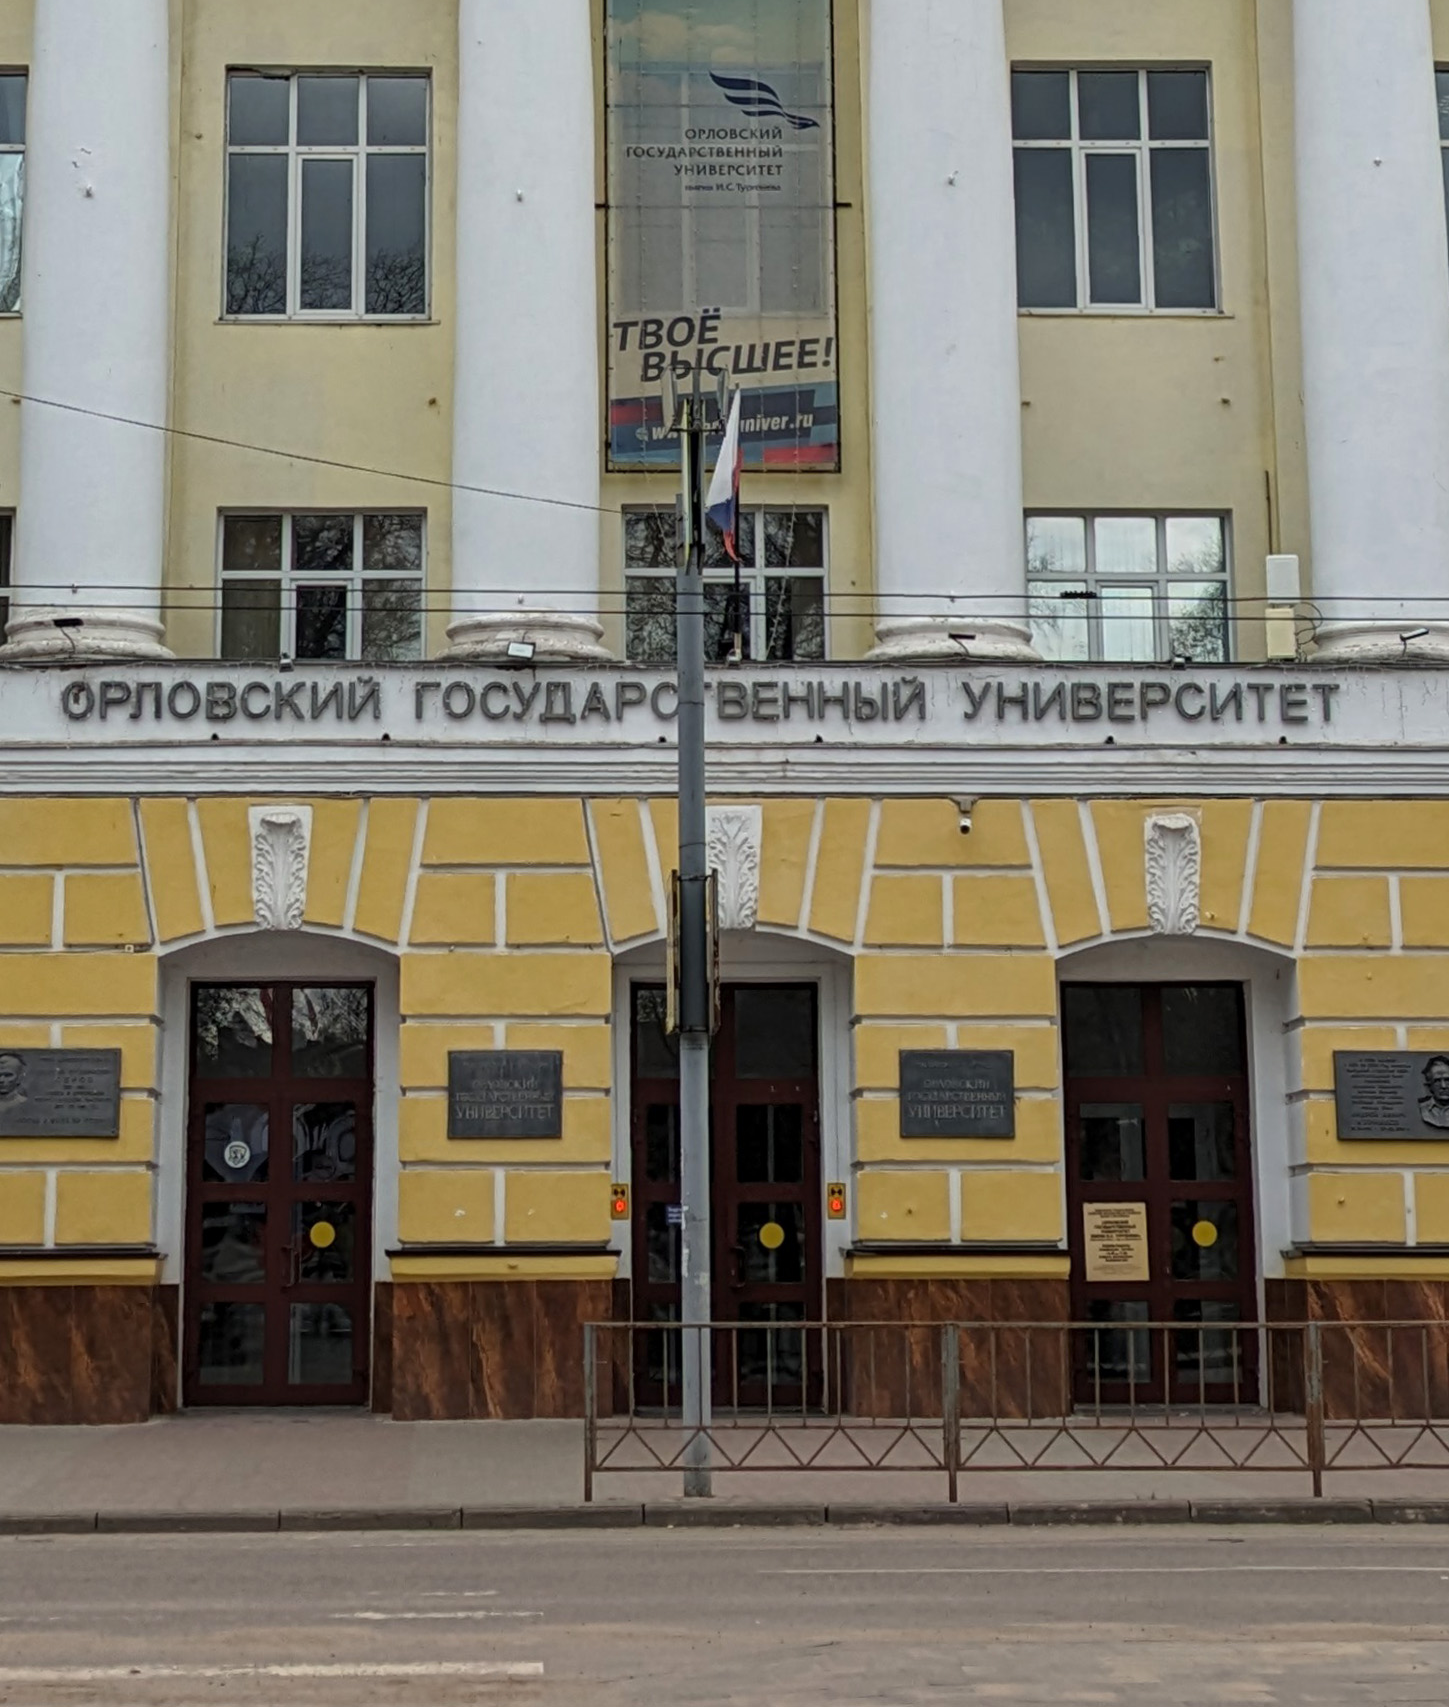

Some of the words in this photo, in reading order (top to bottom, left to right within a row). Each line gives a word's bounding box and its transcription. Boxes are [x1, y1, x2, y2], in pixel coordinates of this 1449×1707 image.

[684, 126, 783, 140] ОРЛОВСКИЙ
[625, 145, 783, 160] ГОСУДАРСТВЕННЫЙ
[673, 164, 784, 177] УНИВЕРСИТЕТ
[612, 307, 722, 352] ТВОЁ
[640, 336, 835, 383] ВЫСШЕЕ!
[61, 675, 382, 720] ОРЛОВСКИЙ
[414, 675, 927, 723] ГОСУДАРСВЕННЫЙ
[961, 679, 1341, 723] УНИВЕРСИТЕТ
